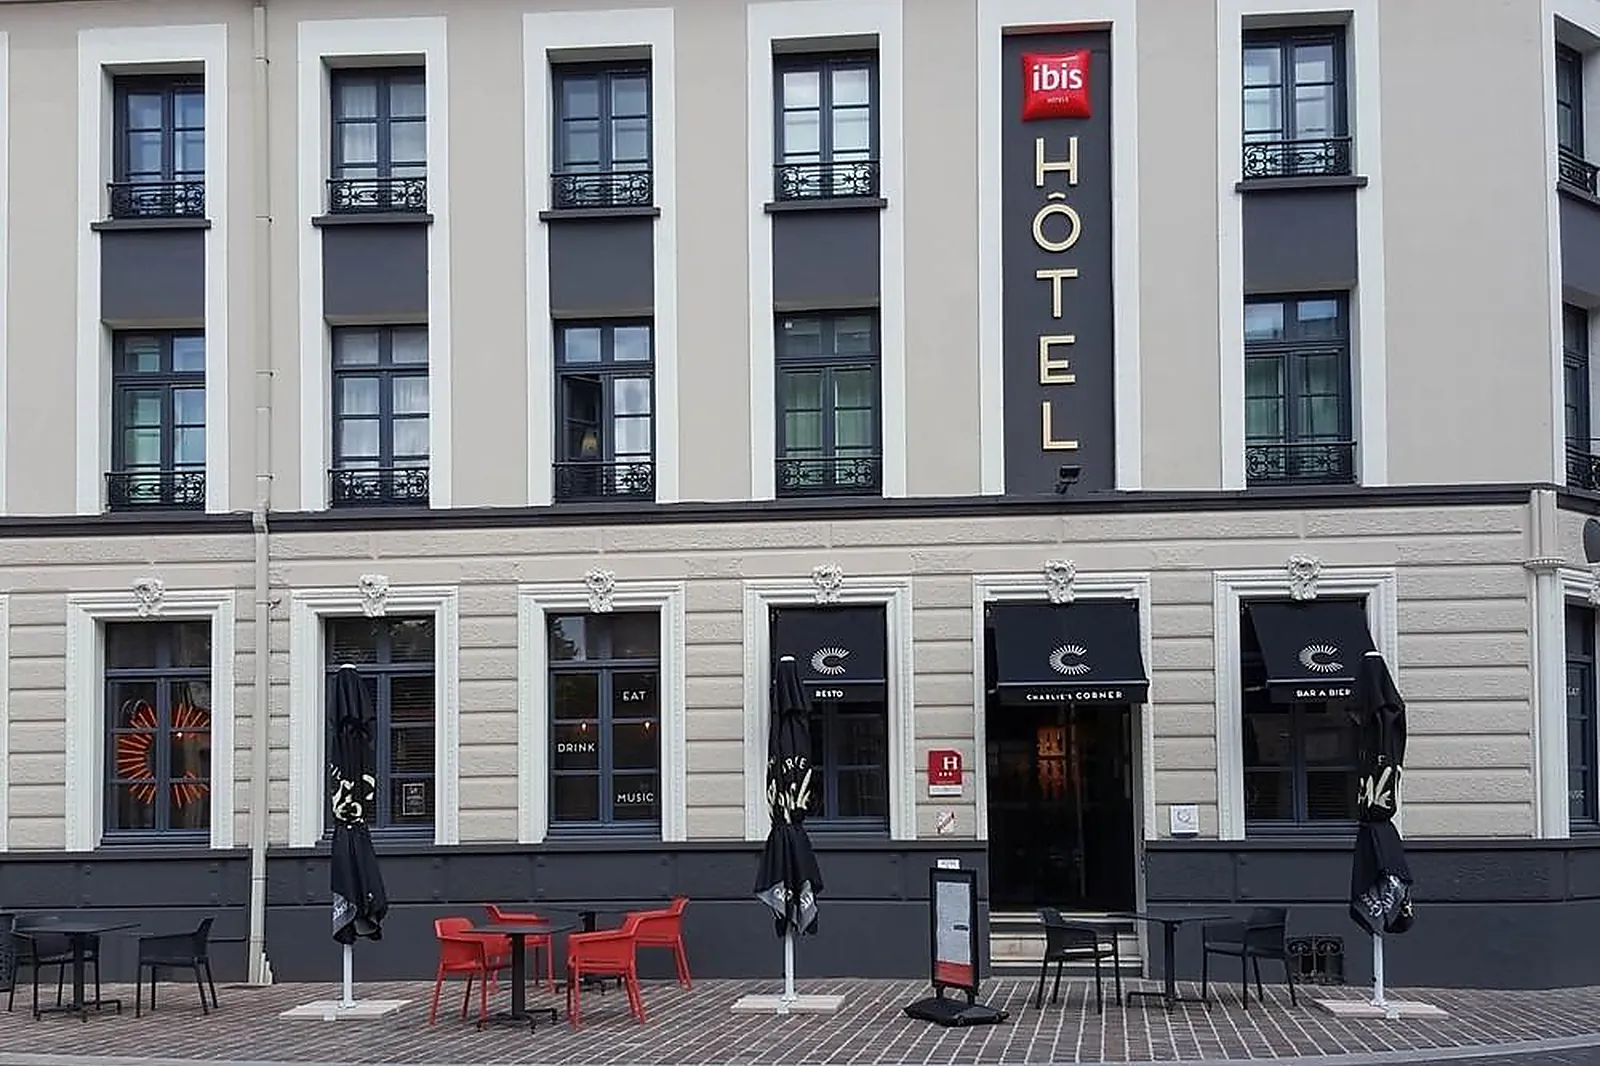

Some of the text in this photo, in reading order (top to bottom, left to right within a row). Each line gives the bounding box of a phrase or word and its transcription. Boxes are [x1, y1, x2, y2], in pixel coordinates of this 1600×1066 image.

[1033, 63, 1083, 91] ibis
[1032, 137, 1082, 450] HÔTEL
[622, 691, 647, 701] EAT
[815, 690, 844, 698] RESTO
[1075, 691, 1123, 699] CORNER
[1296, 689, 1316, 697] BAR
[557, 743, 596, 753] DRINK
[943, 756, 958, 770] H
[616, 793, 655, 803] MUSIC
